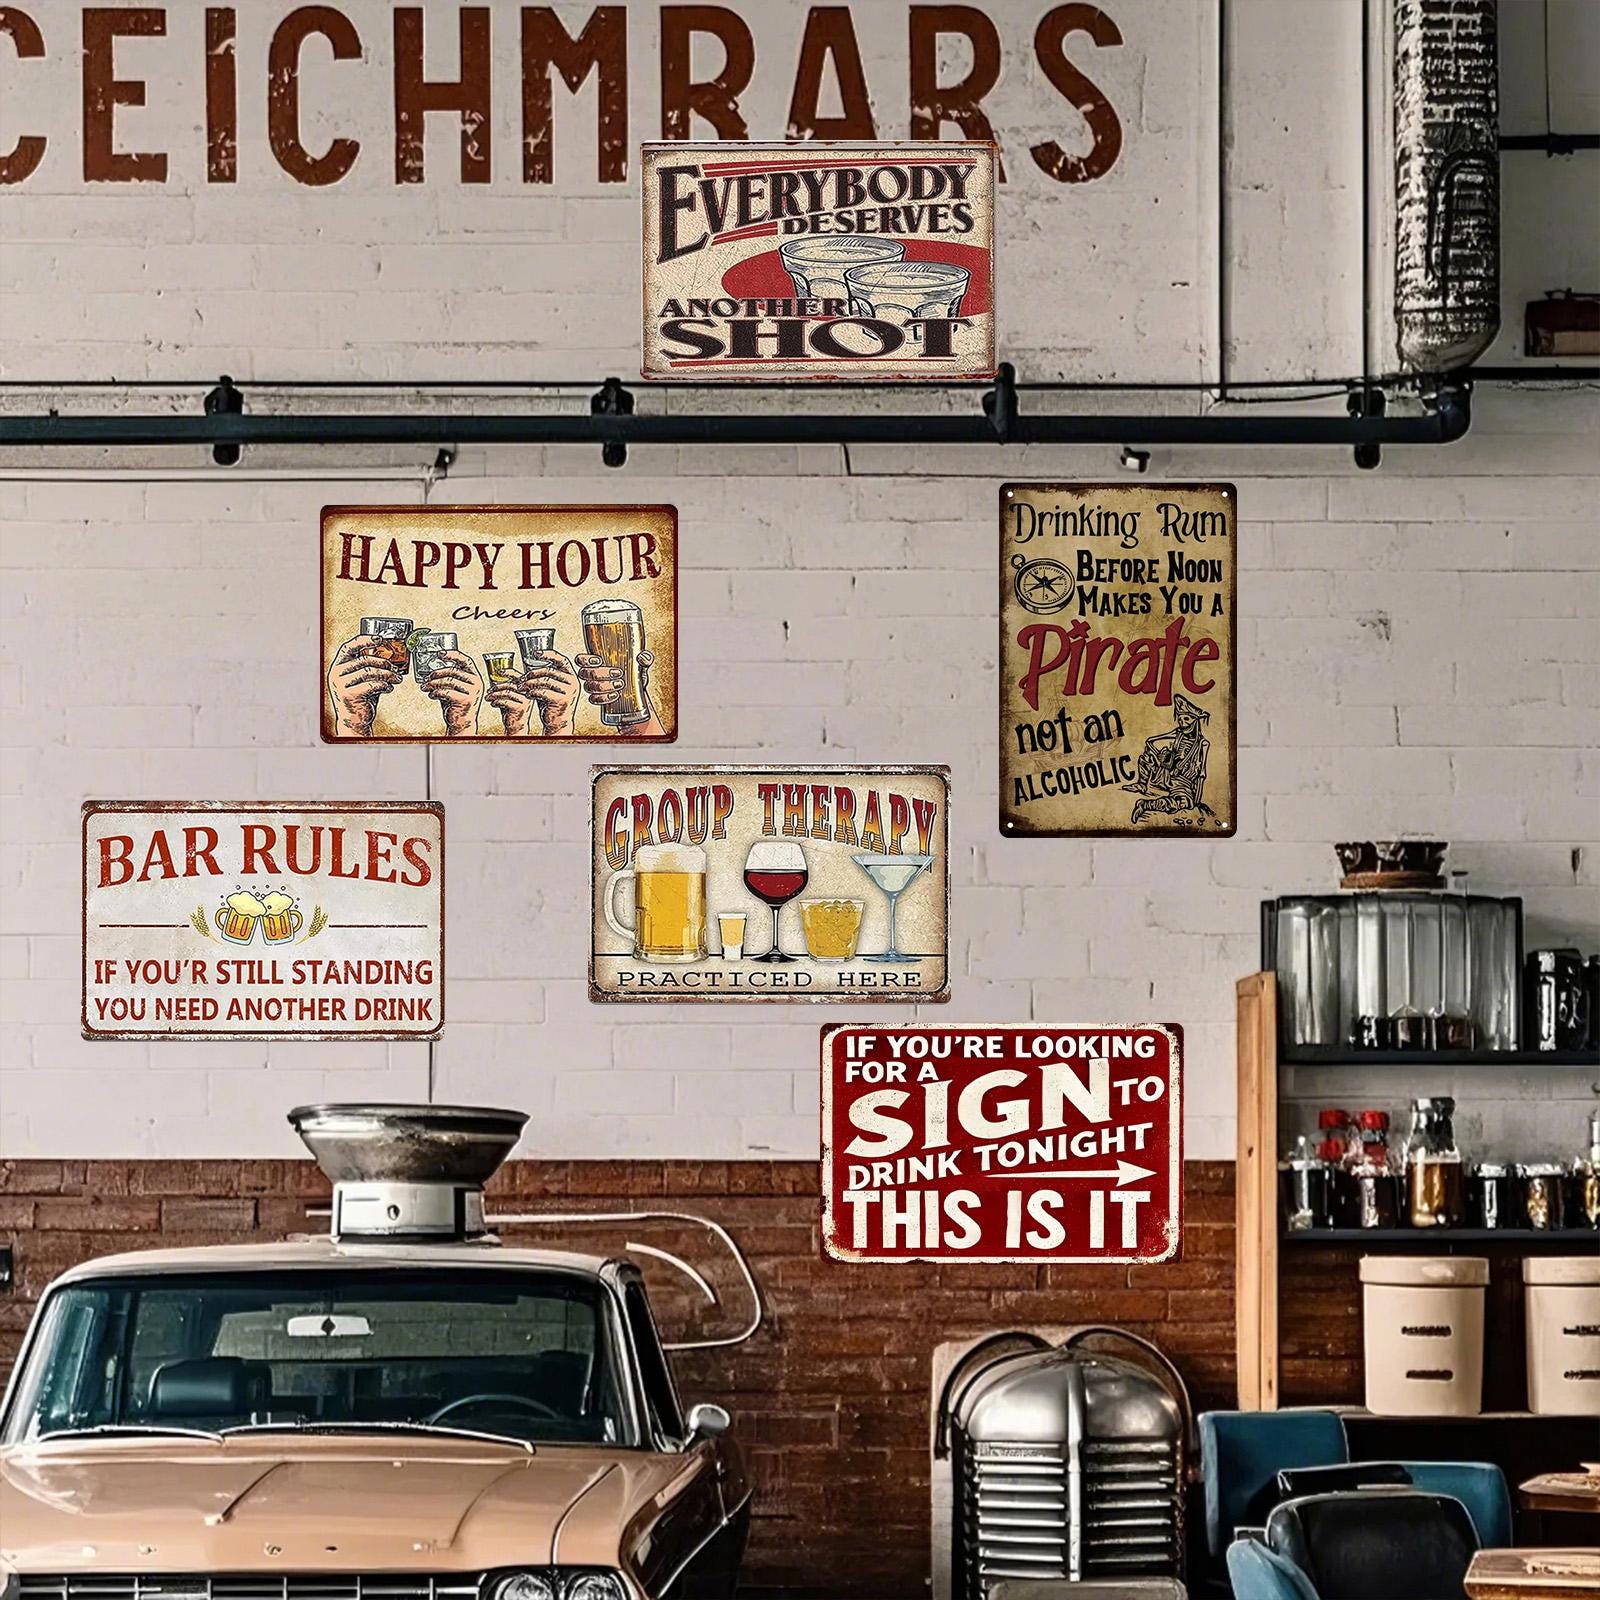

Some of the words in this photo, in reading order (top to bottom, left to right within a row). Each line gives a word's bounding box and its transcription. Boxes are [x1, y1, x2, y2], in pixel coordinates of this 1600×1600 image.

[657, 163, 976, 265] EVERYBODY
[781, 203, 975, 235] DESERVES
[658, 297, 850, 318] ANOTHER
[660, 318, 973, 360] SHOT
[1009, 502, 1141, 549] Drinking
[1156, 503, 1227, 543] Rum
[336, 532, 505, 590] HAPPY
[517, 532, 661, 590] HOUR
[1077, 549, 1160, 585] BEFORE
[1167, 550, 1223, 584] NOON
[452, 605, 556, 621] Cheers
[1077, 586, 1152, 617] MAKES
[1160, 585, 1203, 616] YOU
[1211, 602, 1225, 617] A
[1017, 615, 1220, 711] Pirate
[1014, 706, 1072, 754] not
[1083, 709, 1125, 744] an
[1013, 755, 1136, 806] ALCOHOLIC
[604, 784, 734, 871] GROUP
[758, 783, 937, 869] THERAPY
[97, 826, 224, 888] BAR
[240, 824, 433, 888] RULES
[94, 960, 117, 984] IF
[125, 960, 208, 984] YOU'R
[216, 960, 284, 984] STILL
[292, 960, 433, 984] STANDING
[617, 971, 813, 987] PRACTICED
[837, 971, 922, 987] HERE
[94, 998, 146, 1021] YOU
[155, 998, 219, 1021] NEED
[226, 998, 347, 1021] ANOTHER
[355, 998, 433, 1021] DRINK
[846, 1035, 876, 1058] IF
[887, 1035, 1003, 1058] YOU'RE
[1015, 1035, 1156, 1058] LOOKING
[845, 1061, 905, 1083] FOR
[917, 1061, 940, 1081] A
[843, 1057, 1113, 1158] SIGN
[1113, 1075, 1165, 1105] TO
[848, 1150, 963, 1190] DRINK
[973, 1122, 1153, 1171] TONIGHT
[842, 1189, 982, 1249] THIS
[1005, 1189, 1066, 1249] IS
[1089, 1189, 1151, 1249] IT
